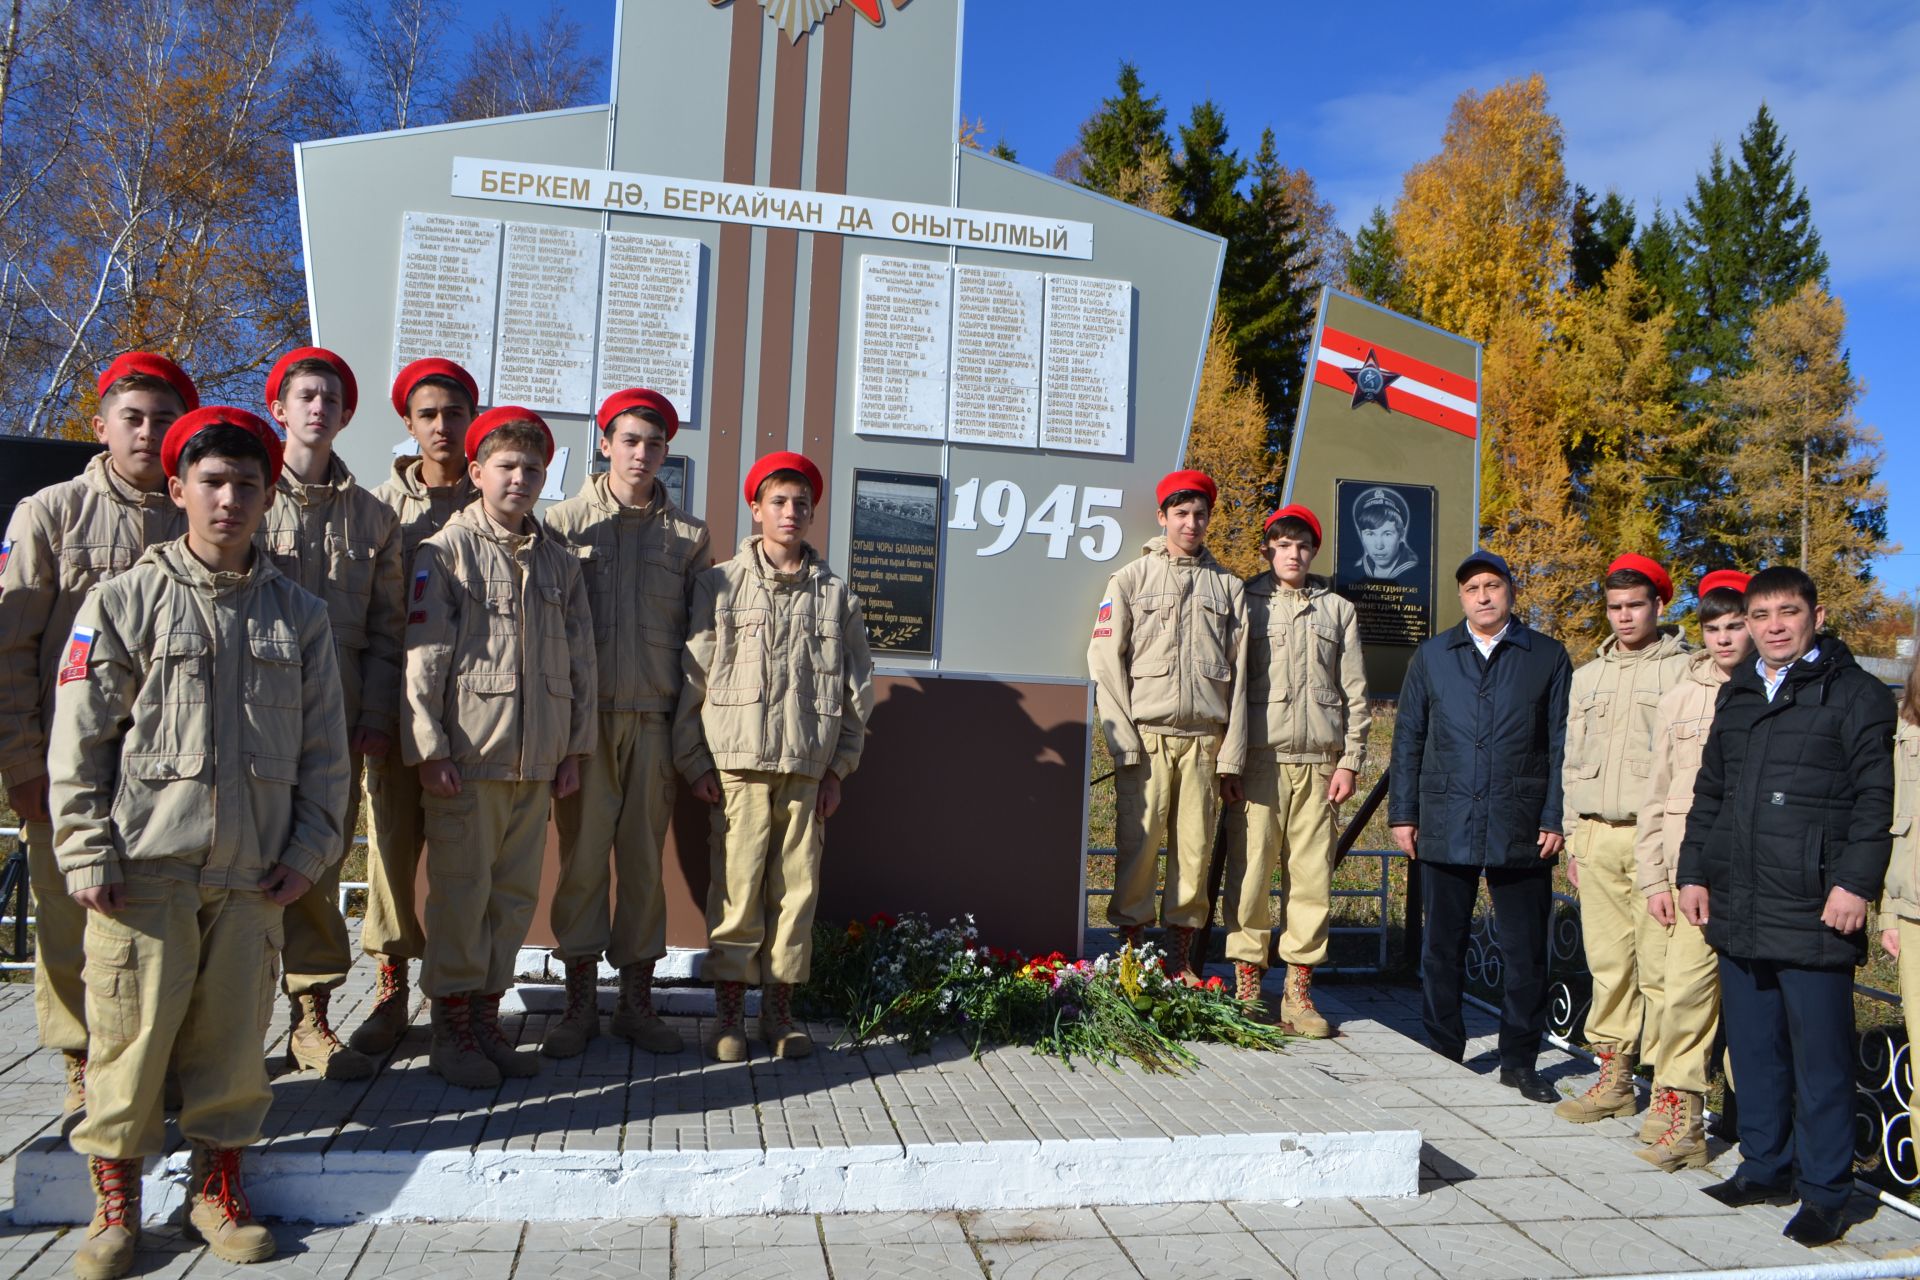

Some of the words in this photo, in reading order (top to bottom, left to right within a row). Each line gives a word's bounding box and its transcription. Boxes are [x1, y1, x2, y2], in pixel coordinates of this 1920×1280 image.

[481, 170, 590, 201] БЕРКЕМ
[604, 180, 649, 211] ДӘ,
[664, 186, 823, 224] БЕРКАЙЧАН
[837, 206, 874, 232] ДА
[891, 211, 1068, 252] ОНЫТЫЛМЫЙ
[948, 477, 1124, 562] 1945
[877, 542, 893, 552] ЧОРЫ
[1362, 593, 1404, 602] АЛЬБЕРТ
